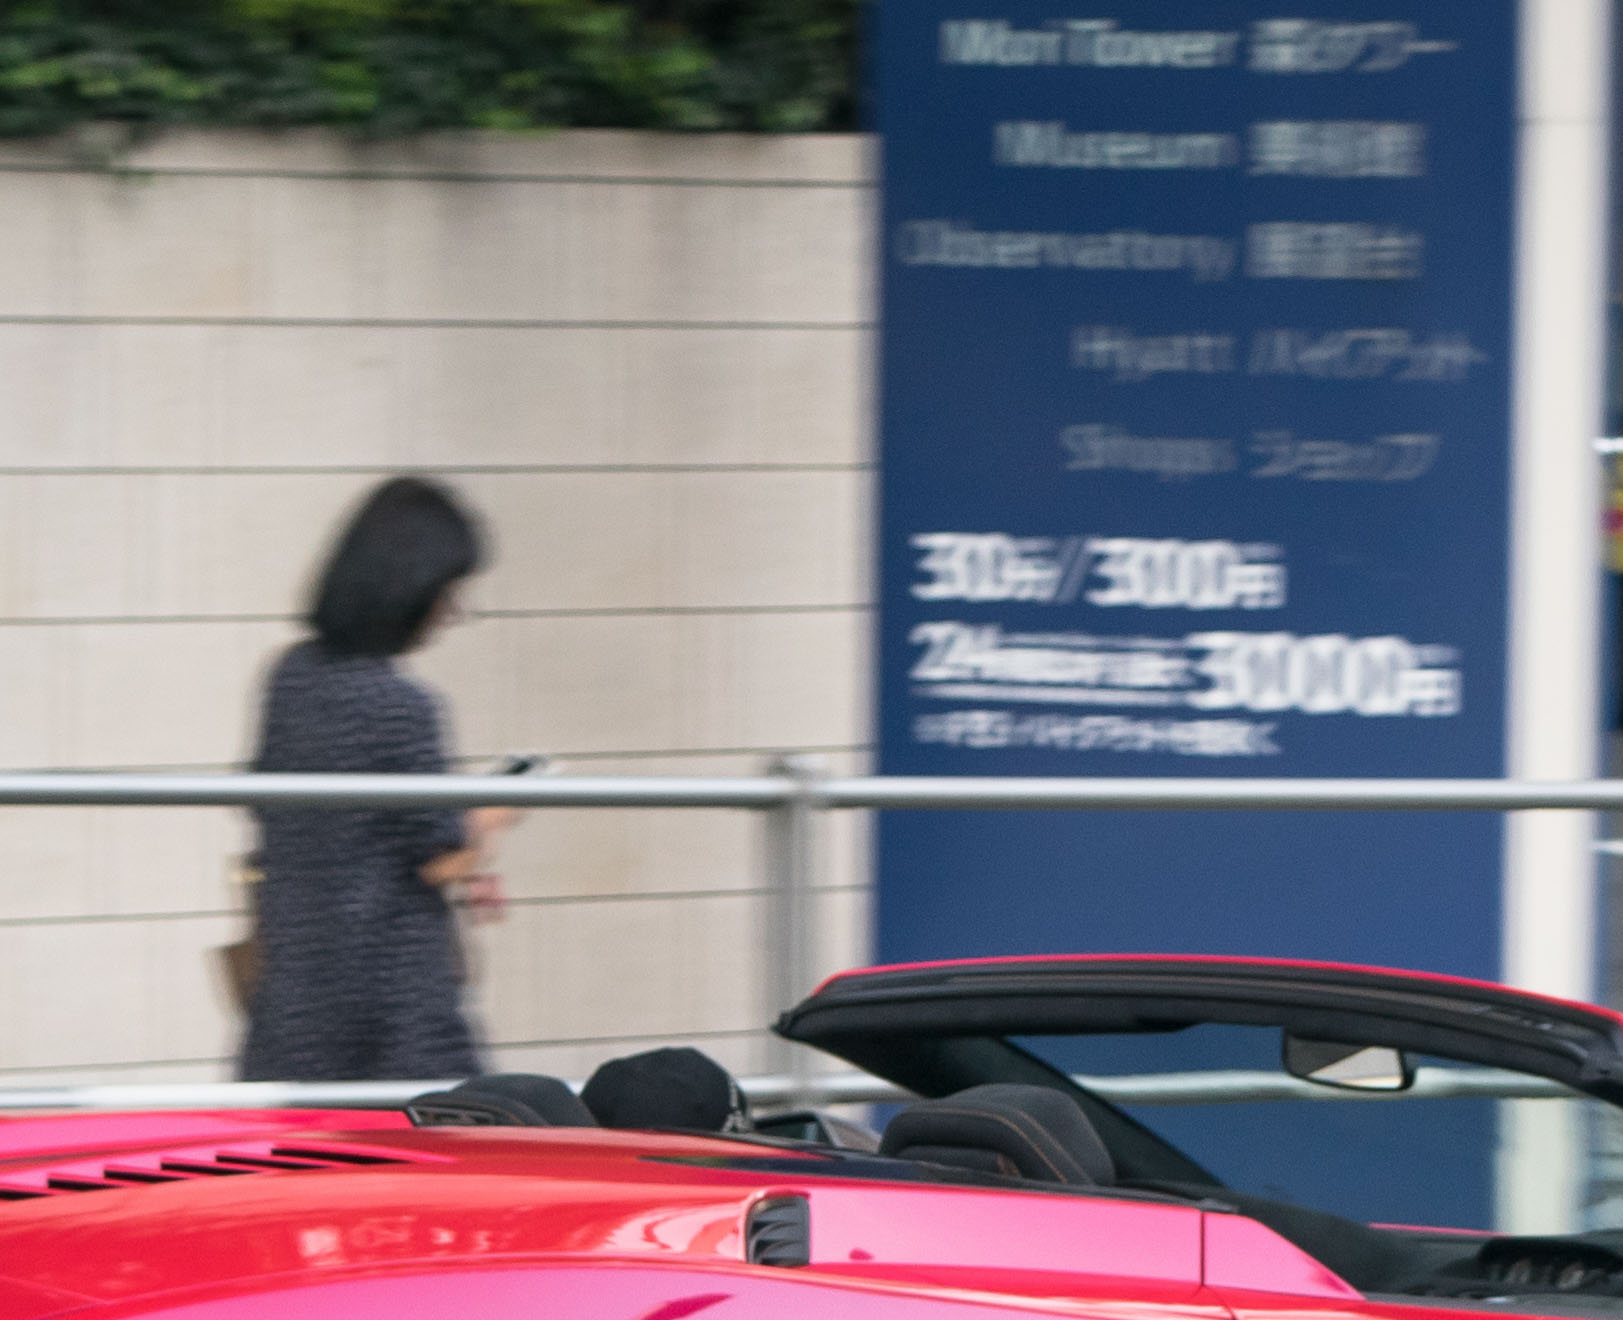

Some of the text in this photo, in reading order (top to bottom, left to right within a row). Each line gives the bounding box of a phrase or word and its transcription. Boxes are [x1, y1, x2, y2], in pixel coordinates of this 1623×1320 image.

[1062, 20, 1238, 67] Tower
[994, 120, 1234, 168] Museum
[898, 220, 1234, 282] Observatory
[1072, 326, 1234, 382] Hyatt
[1059, 424, 1236, 482] Shops
